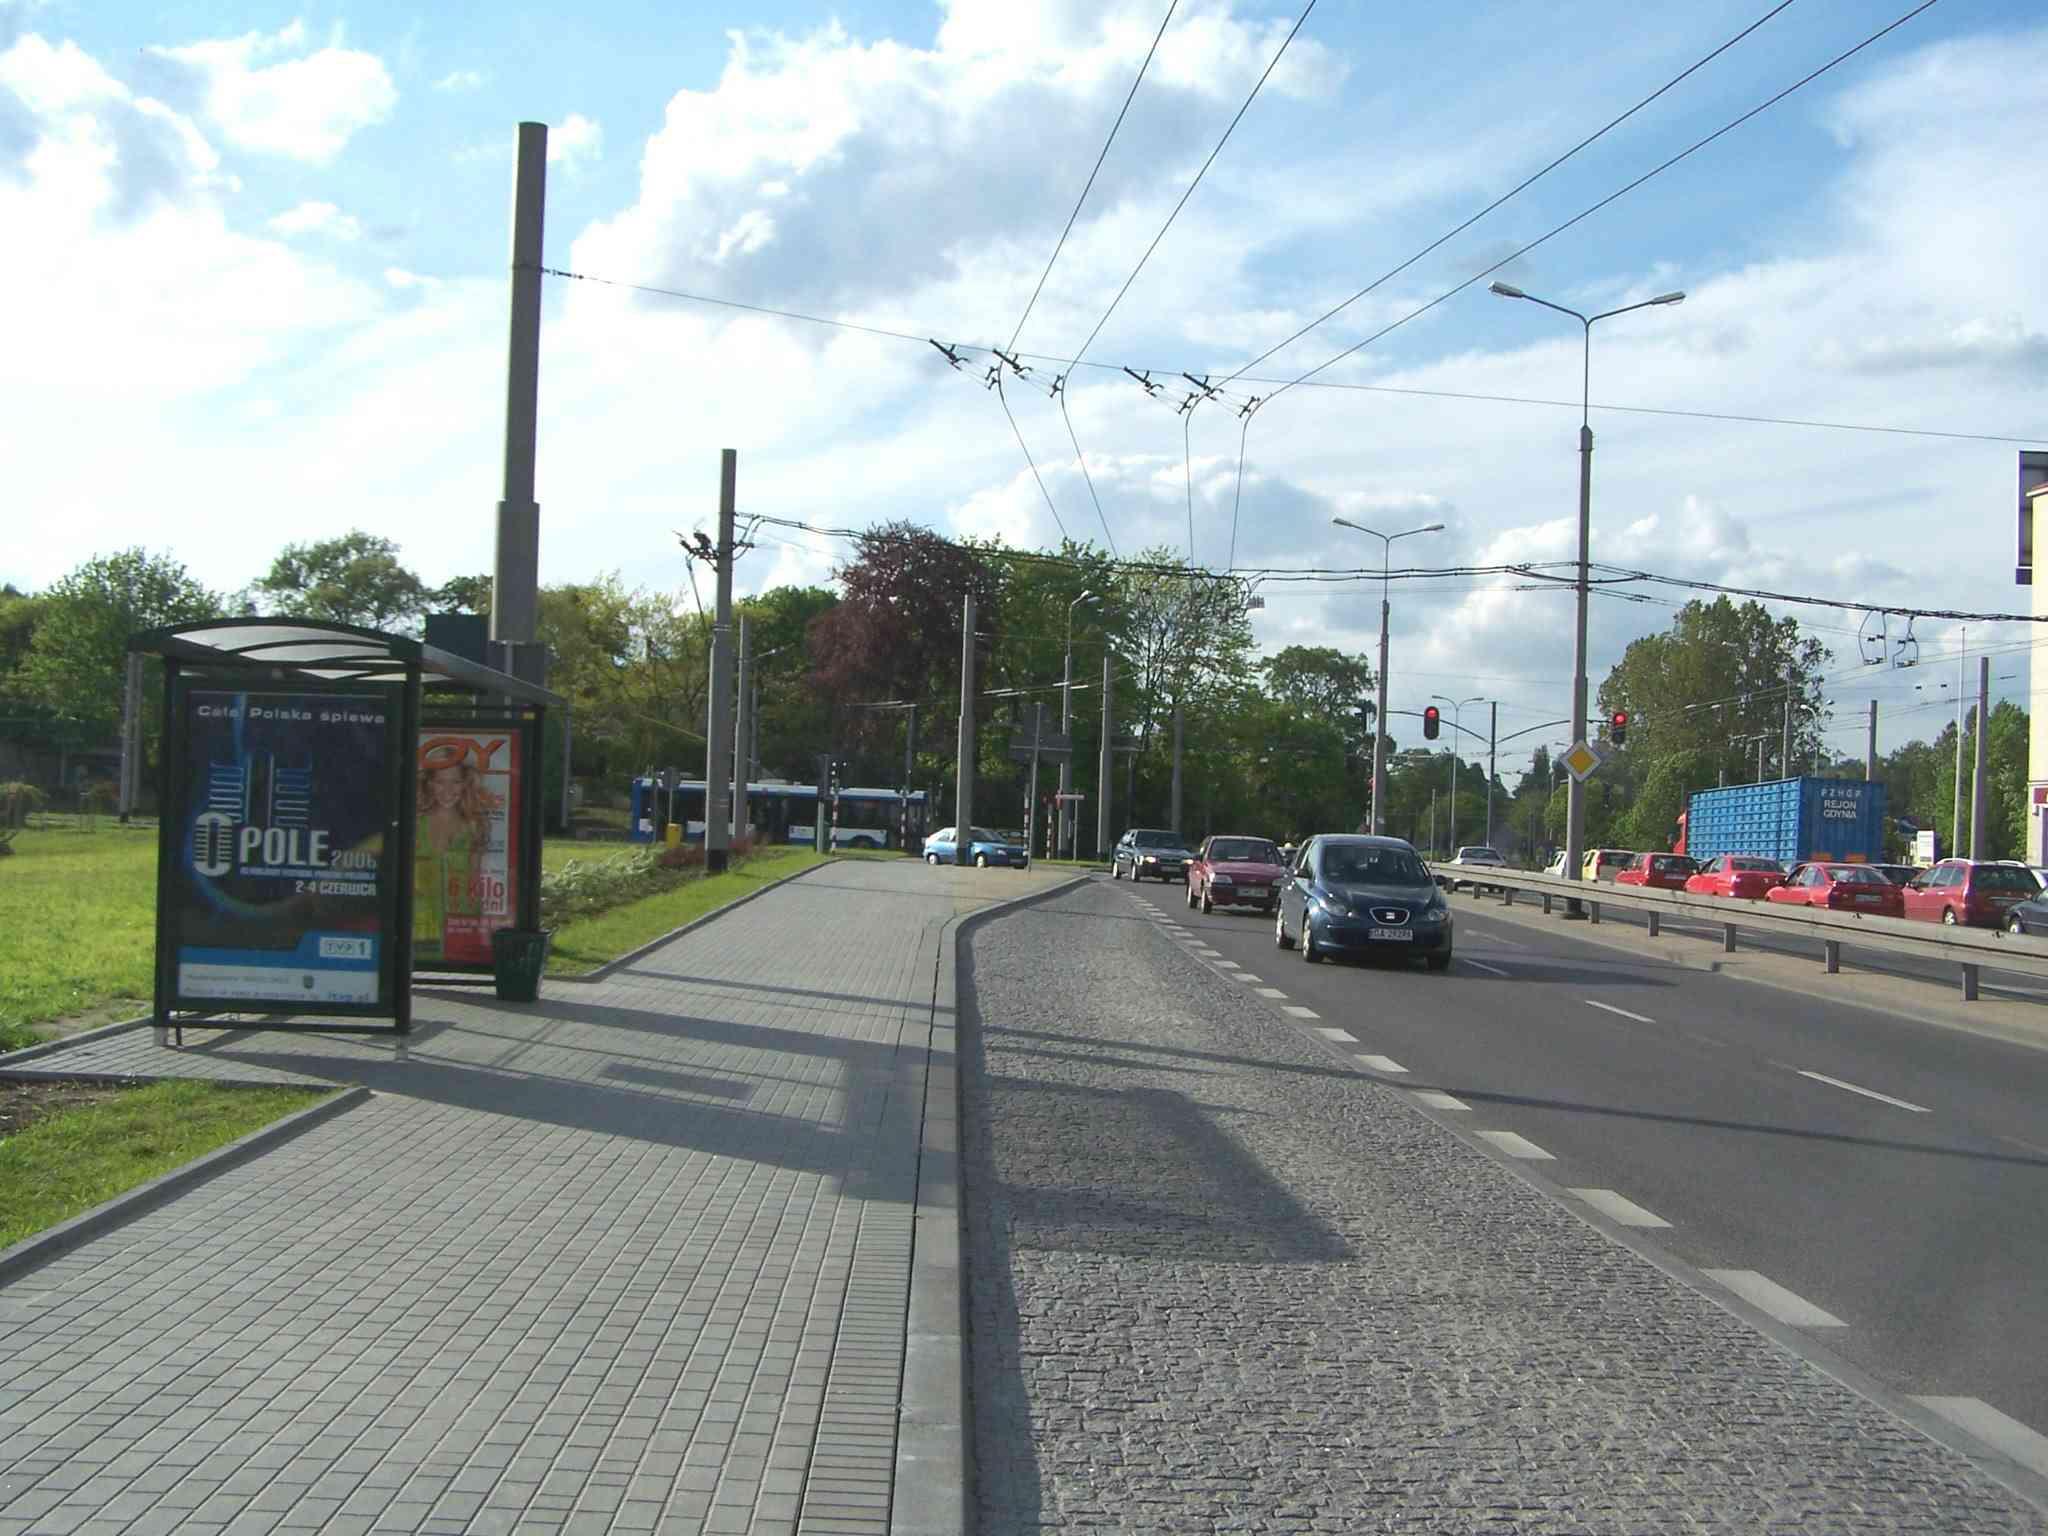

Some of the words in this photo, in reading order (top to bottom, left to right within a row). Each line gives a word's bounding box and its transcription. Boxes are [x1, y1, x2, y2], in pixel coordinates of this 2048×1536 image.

[249, 707, 312, 721] Polska
[1823, 799, 1857, 809] REJON
[1823, 809, 1857, 819] GDYNIA
